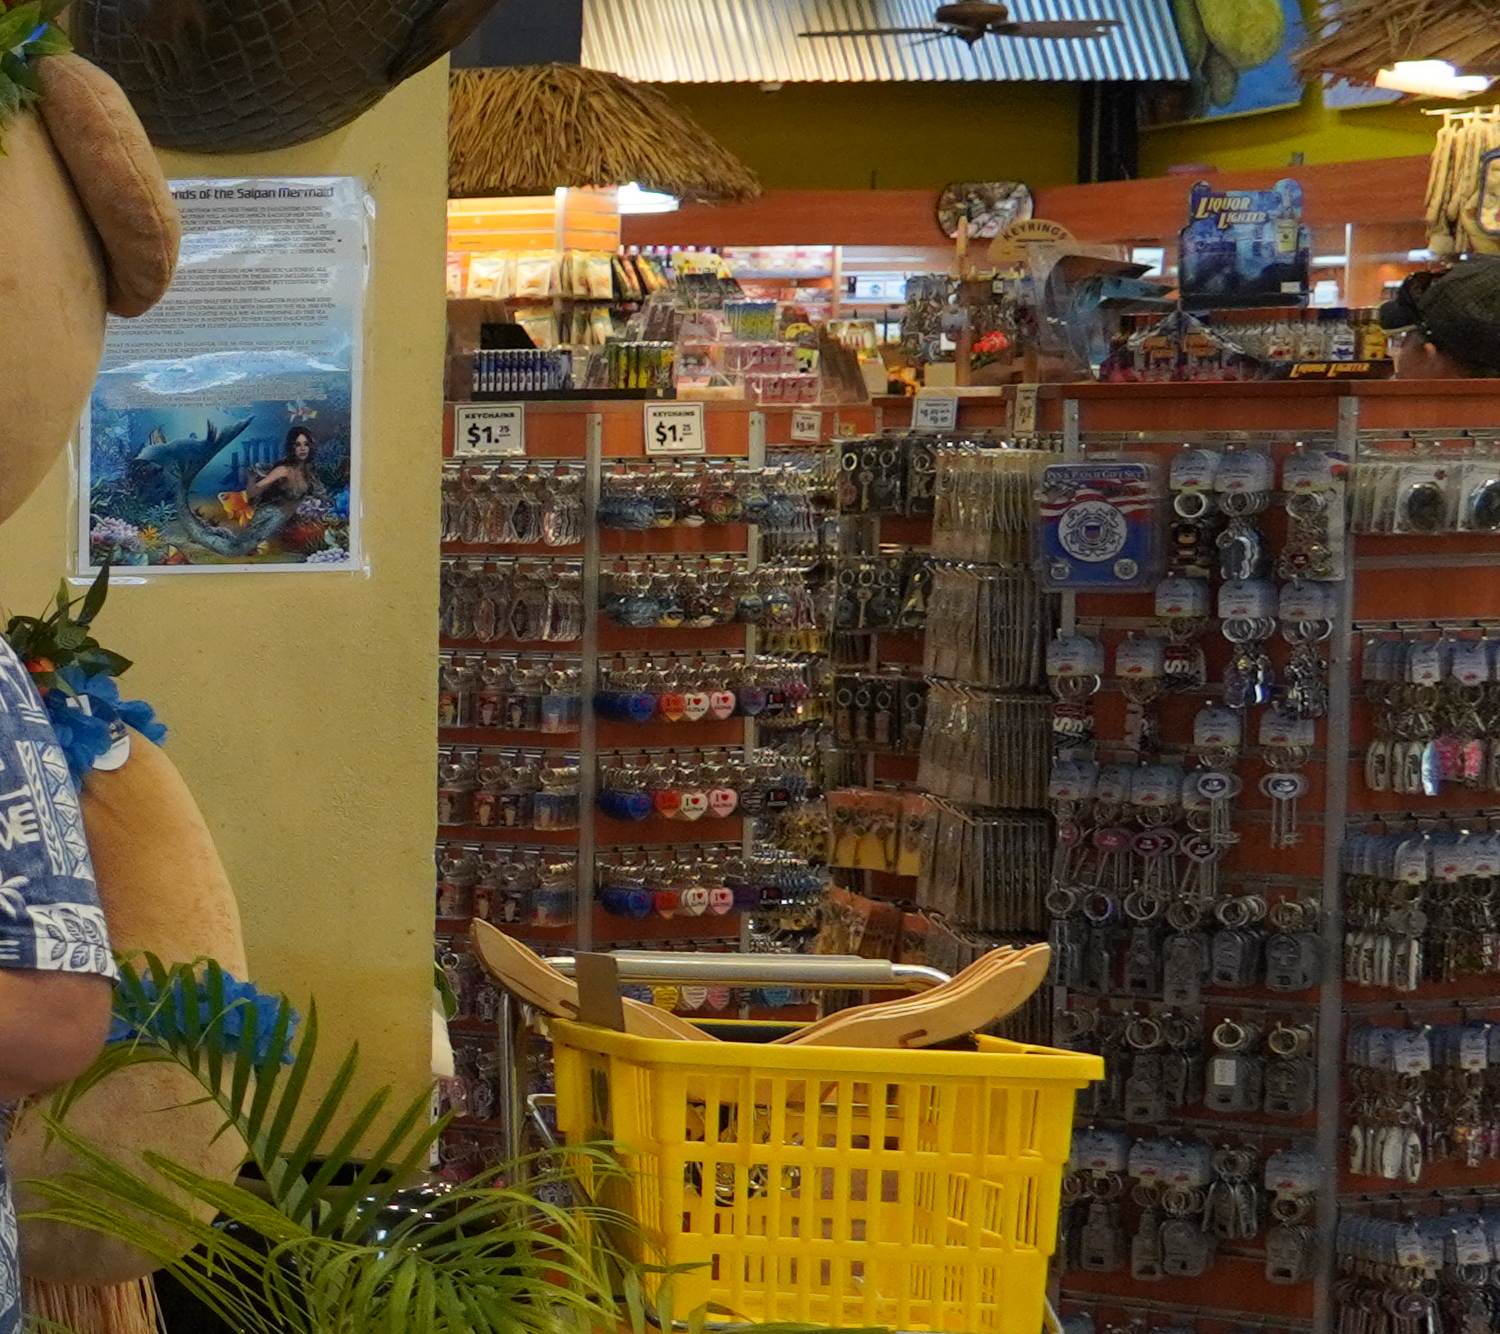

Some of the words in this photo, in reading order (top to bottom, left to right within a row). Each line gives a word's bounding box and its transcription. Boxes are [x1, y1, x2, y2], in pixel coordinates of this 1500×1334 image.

[171, 188, 197, 200] nds
[199, 188, 213, 199] of
[214, 188, 234, 199] the
[237, 187, 275, 200] Saipan
[1003, 223, 1067, 242] KEYRINGS
[464, 411, 515, 420] KEYCHAINS
[652, 410, 696, 418] KEYCHAINS
